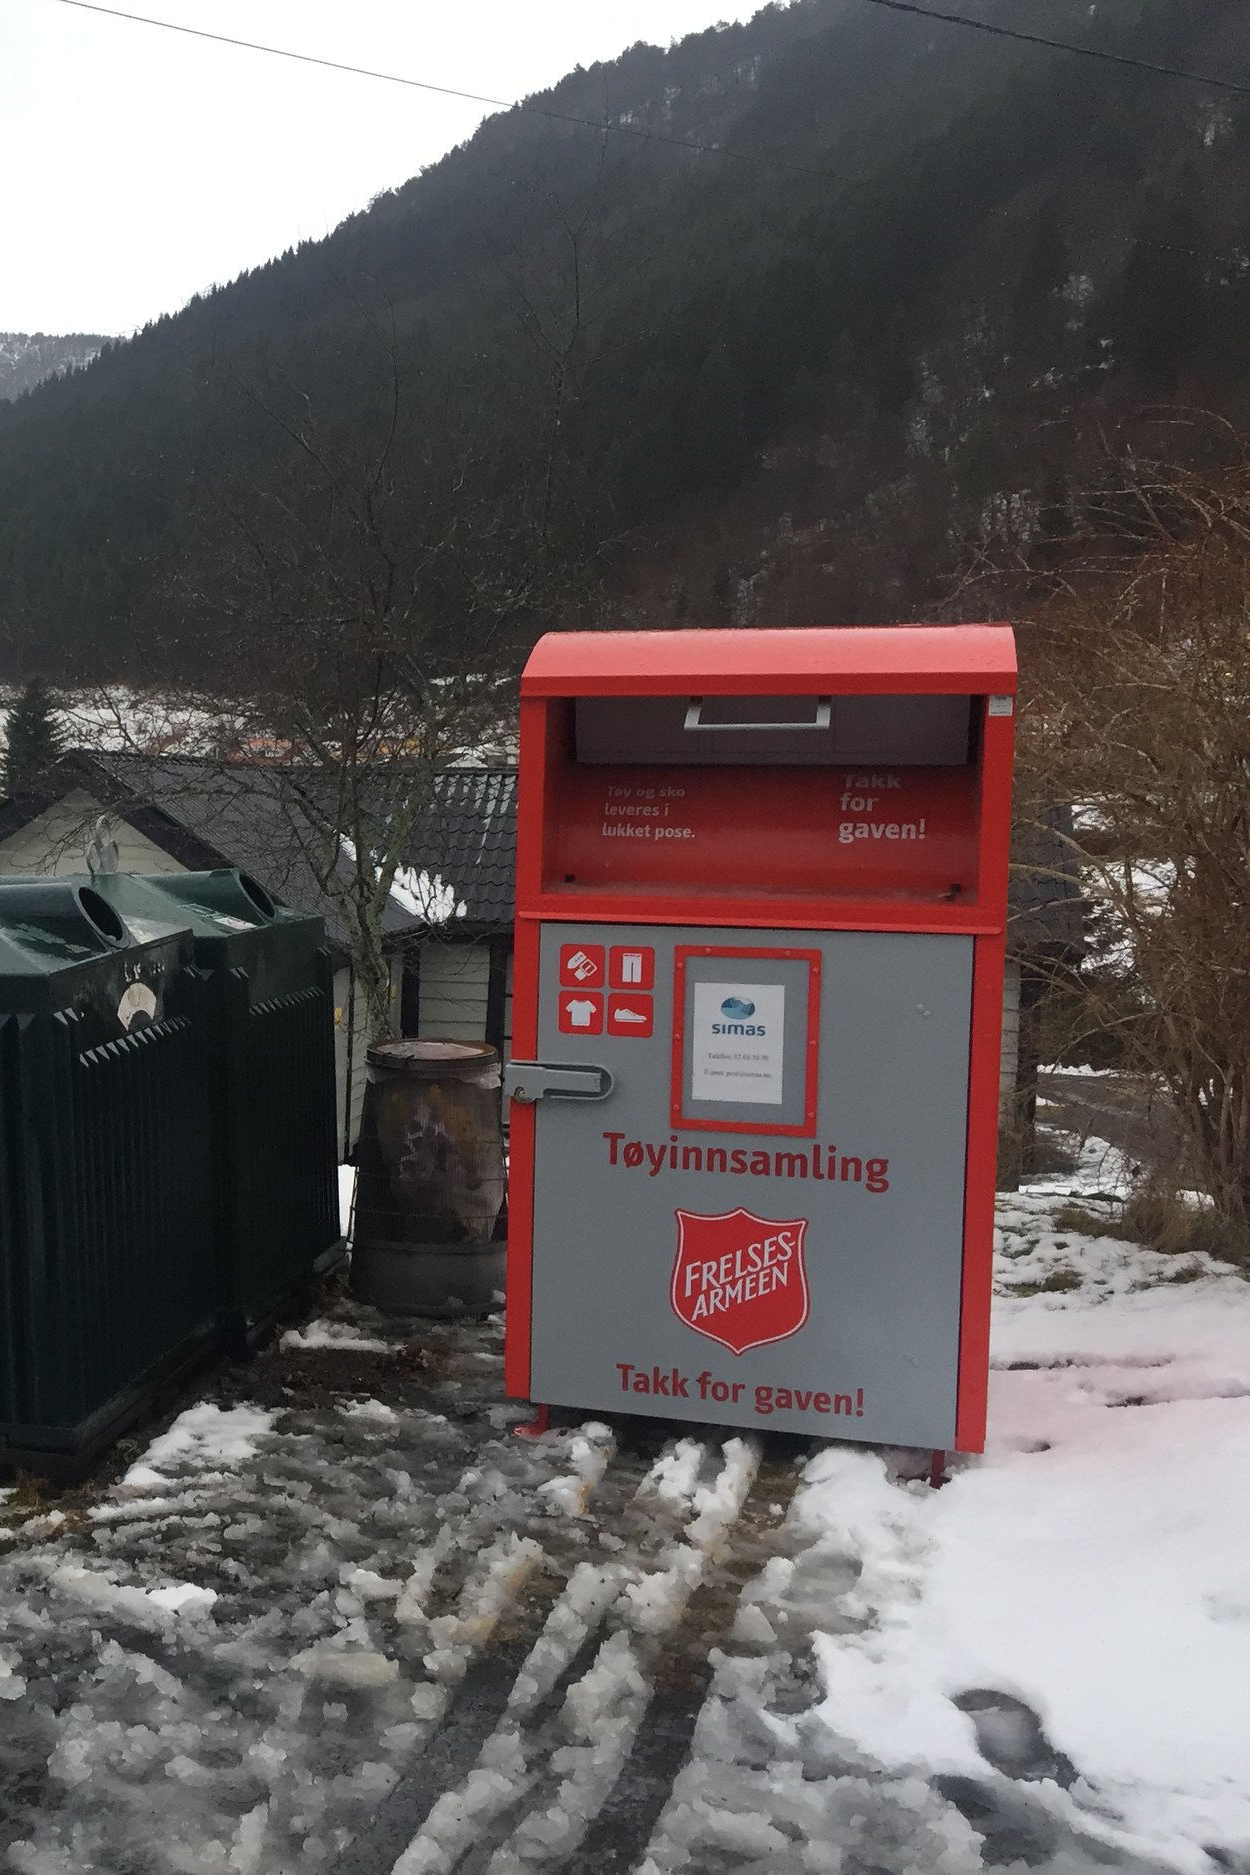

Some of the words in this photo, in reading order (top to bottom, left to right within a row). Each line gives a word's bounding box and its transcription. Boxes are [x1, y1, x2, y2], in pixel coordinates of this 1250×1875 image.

[842, 772, 902, 789] Takk
[636, 787, 655, 799] og
[658, 786, 686, 797] sko
[839, 792, 879, 811] for
[604, 802, 660, 816] leveres
[664, 803, 670, 816] i
[602, 822, 651, 837] lukket
[654, 827, 695, 841] pose.
[838, 818, 926, 844] gaven!
[711, 1023, 766, 1037] simas
[603, 1132, 889, 1193] Tøyinnsamling
[684, 1231, 797, 1298] FRELSES-
[691, 1261, 789, 1321] ARMEEN
[616, 1363, 690, 1398] Takk
[697, 1371, 746, 1403] for
[754, 1385, 865, 1417] gaven!
